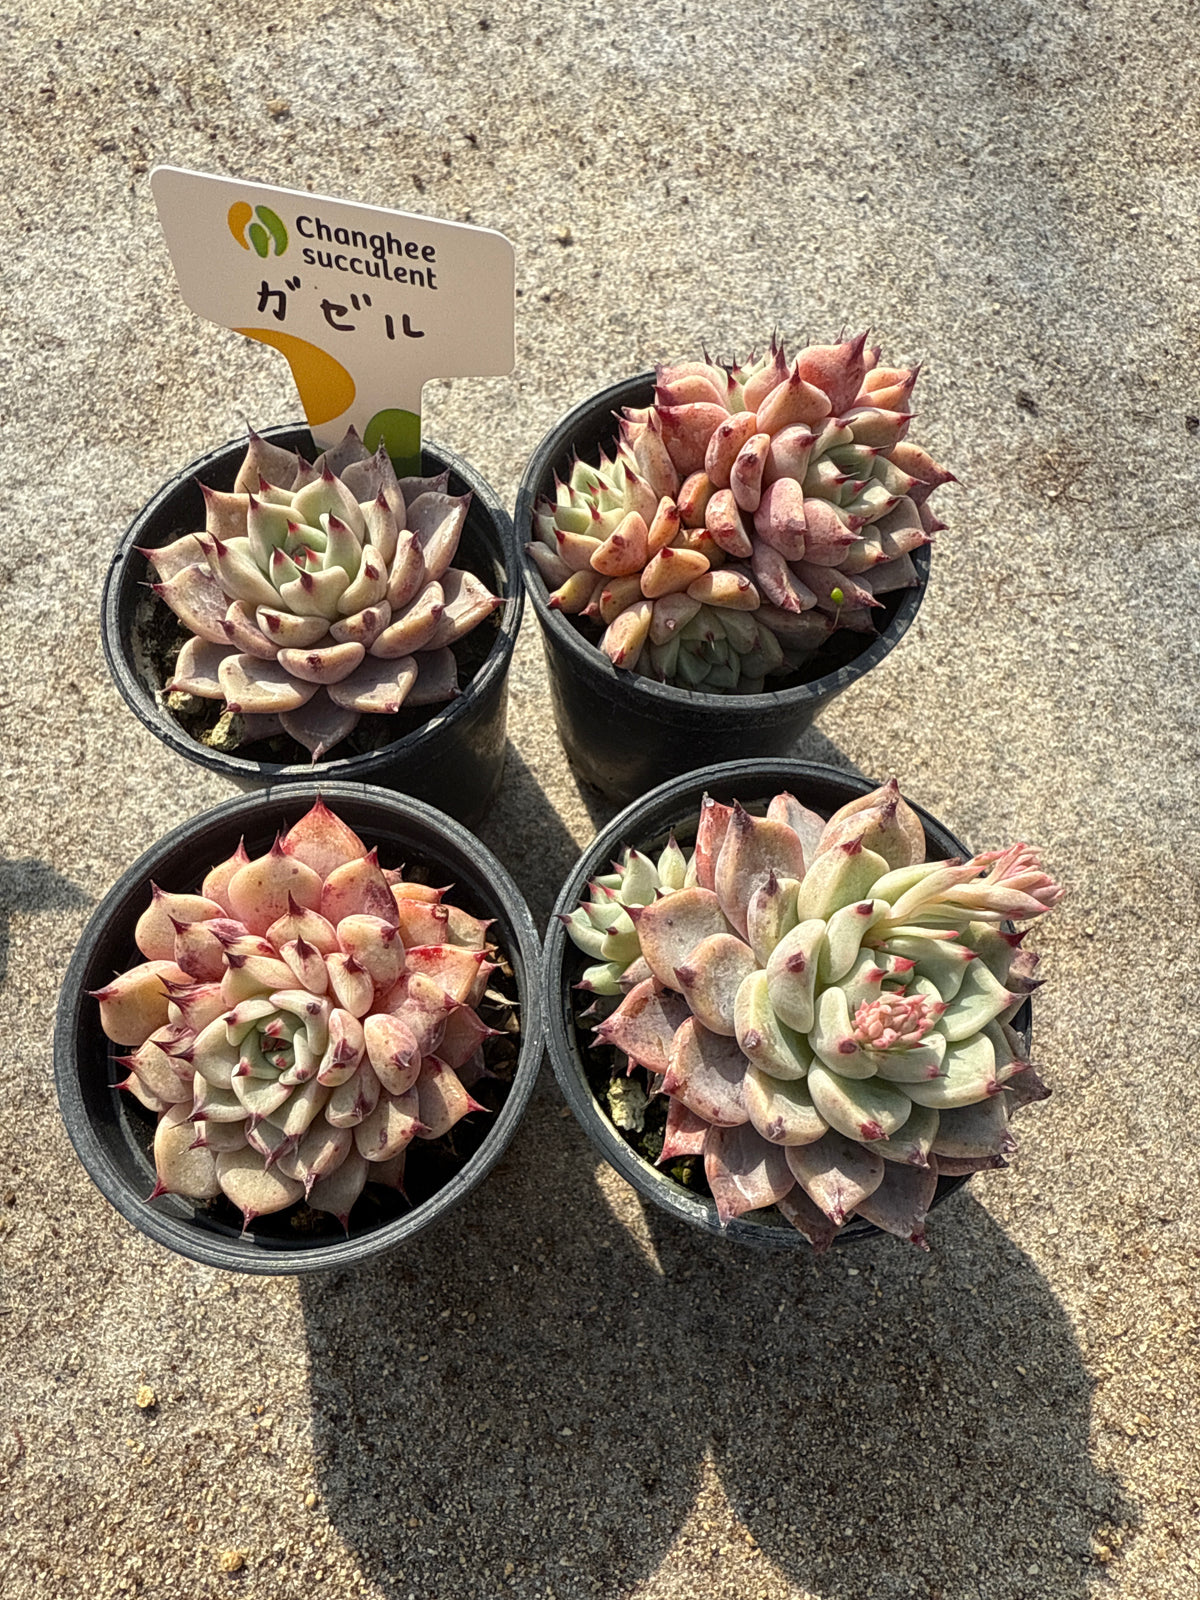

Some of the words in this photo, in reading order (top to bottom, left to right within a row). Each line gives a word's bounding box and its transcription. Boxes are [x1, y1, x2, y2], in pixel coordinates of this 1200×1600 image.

[296, 215, 436, 263] Changhee
[302, 247, 438, 290] succulent
[257, 275, 425, 340] ガゼル
